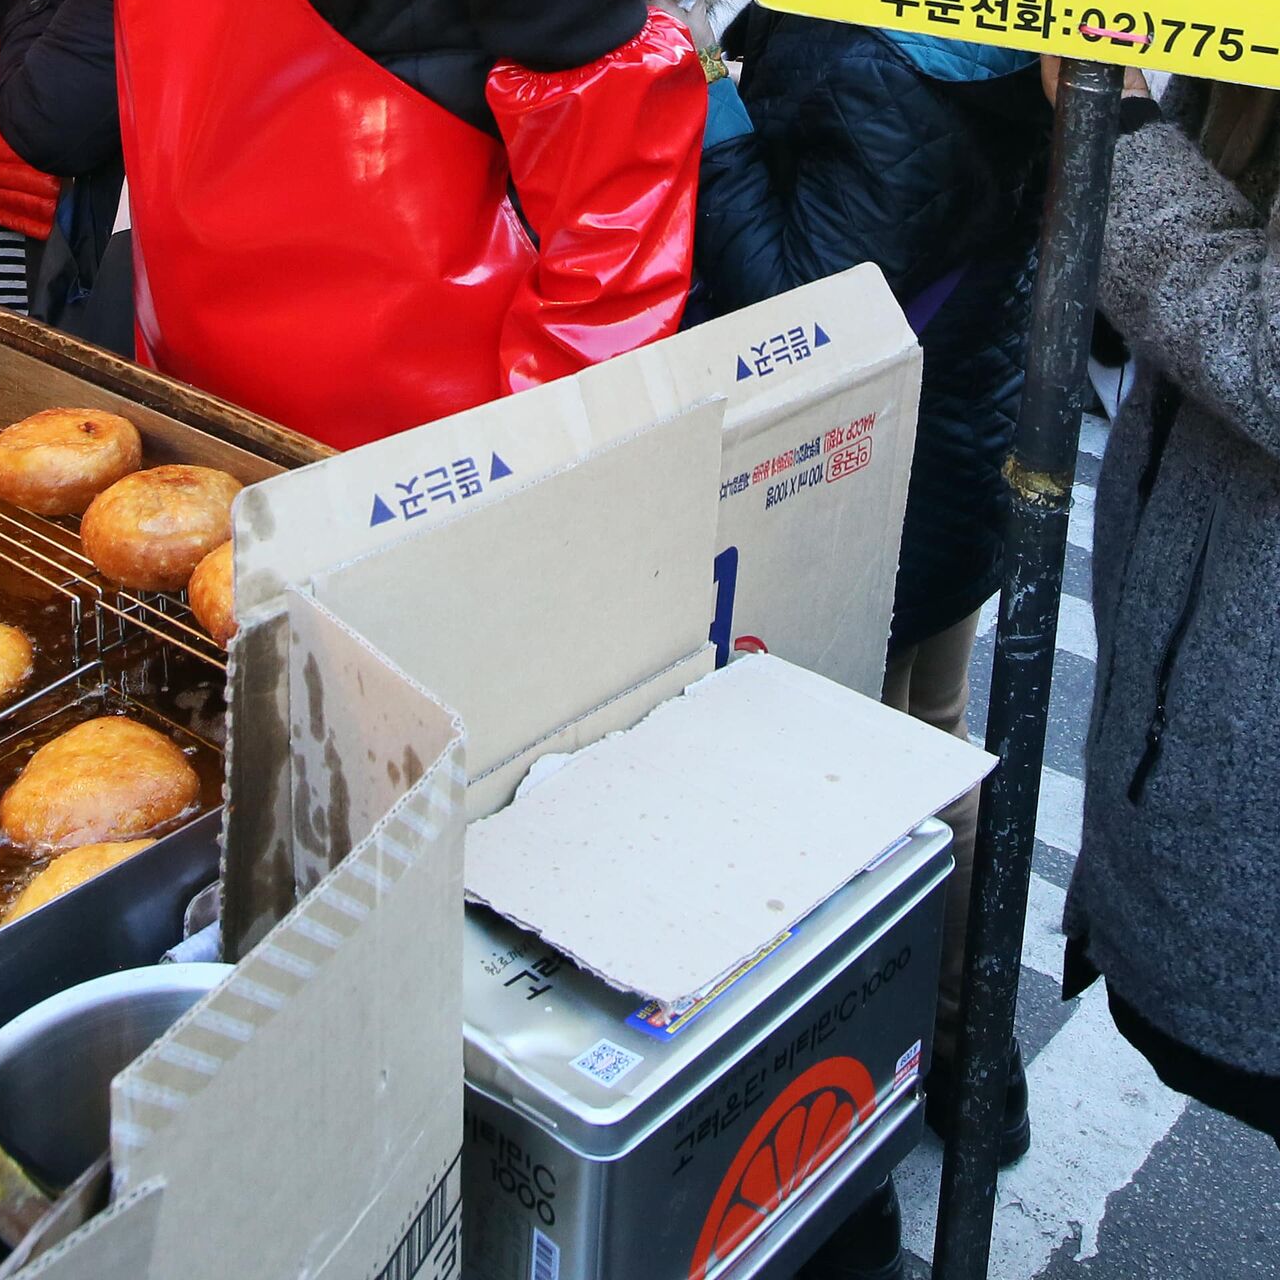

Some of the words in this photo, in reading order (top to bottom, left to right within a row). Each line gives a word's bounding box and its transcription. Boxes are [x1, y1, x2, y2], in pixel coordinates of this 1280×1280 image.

[753, 325, 812, 378] 뜯는곳
[846, 412, 877, 440] HACCP
[831, 445, 868, 477] 약국용
[397, 455, 484, 521] 뜯는곳
[491, 1156, 556, 1227] 1000
